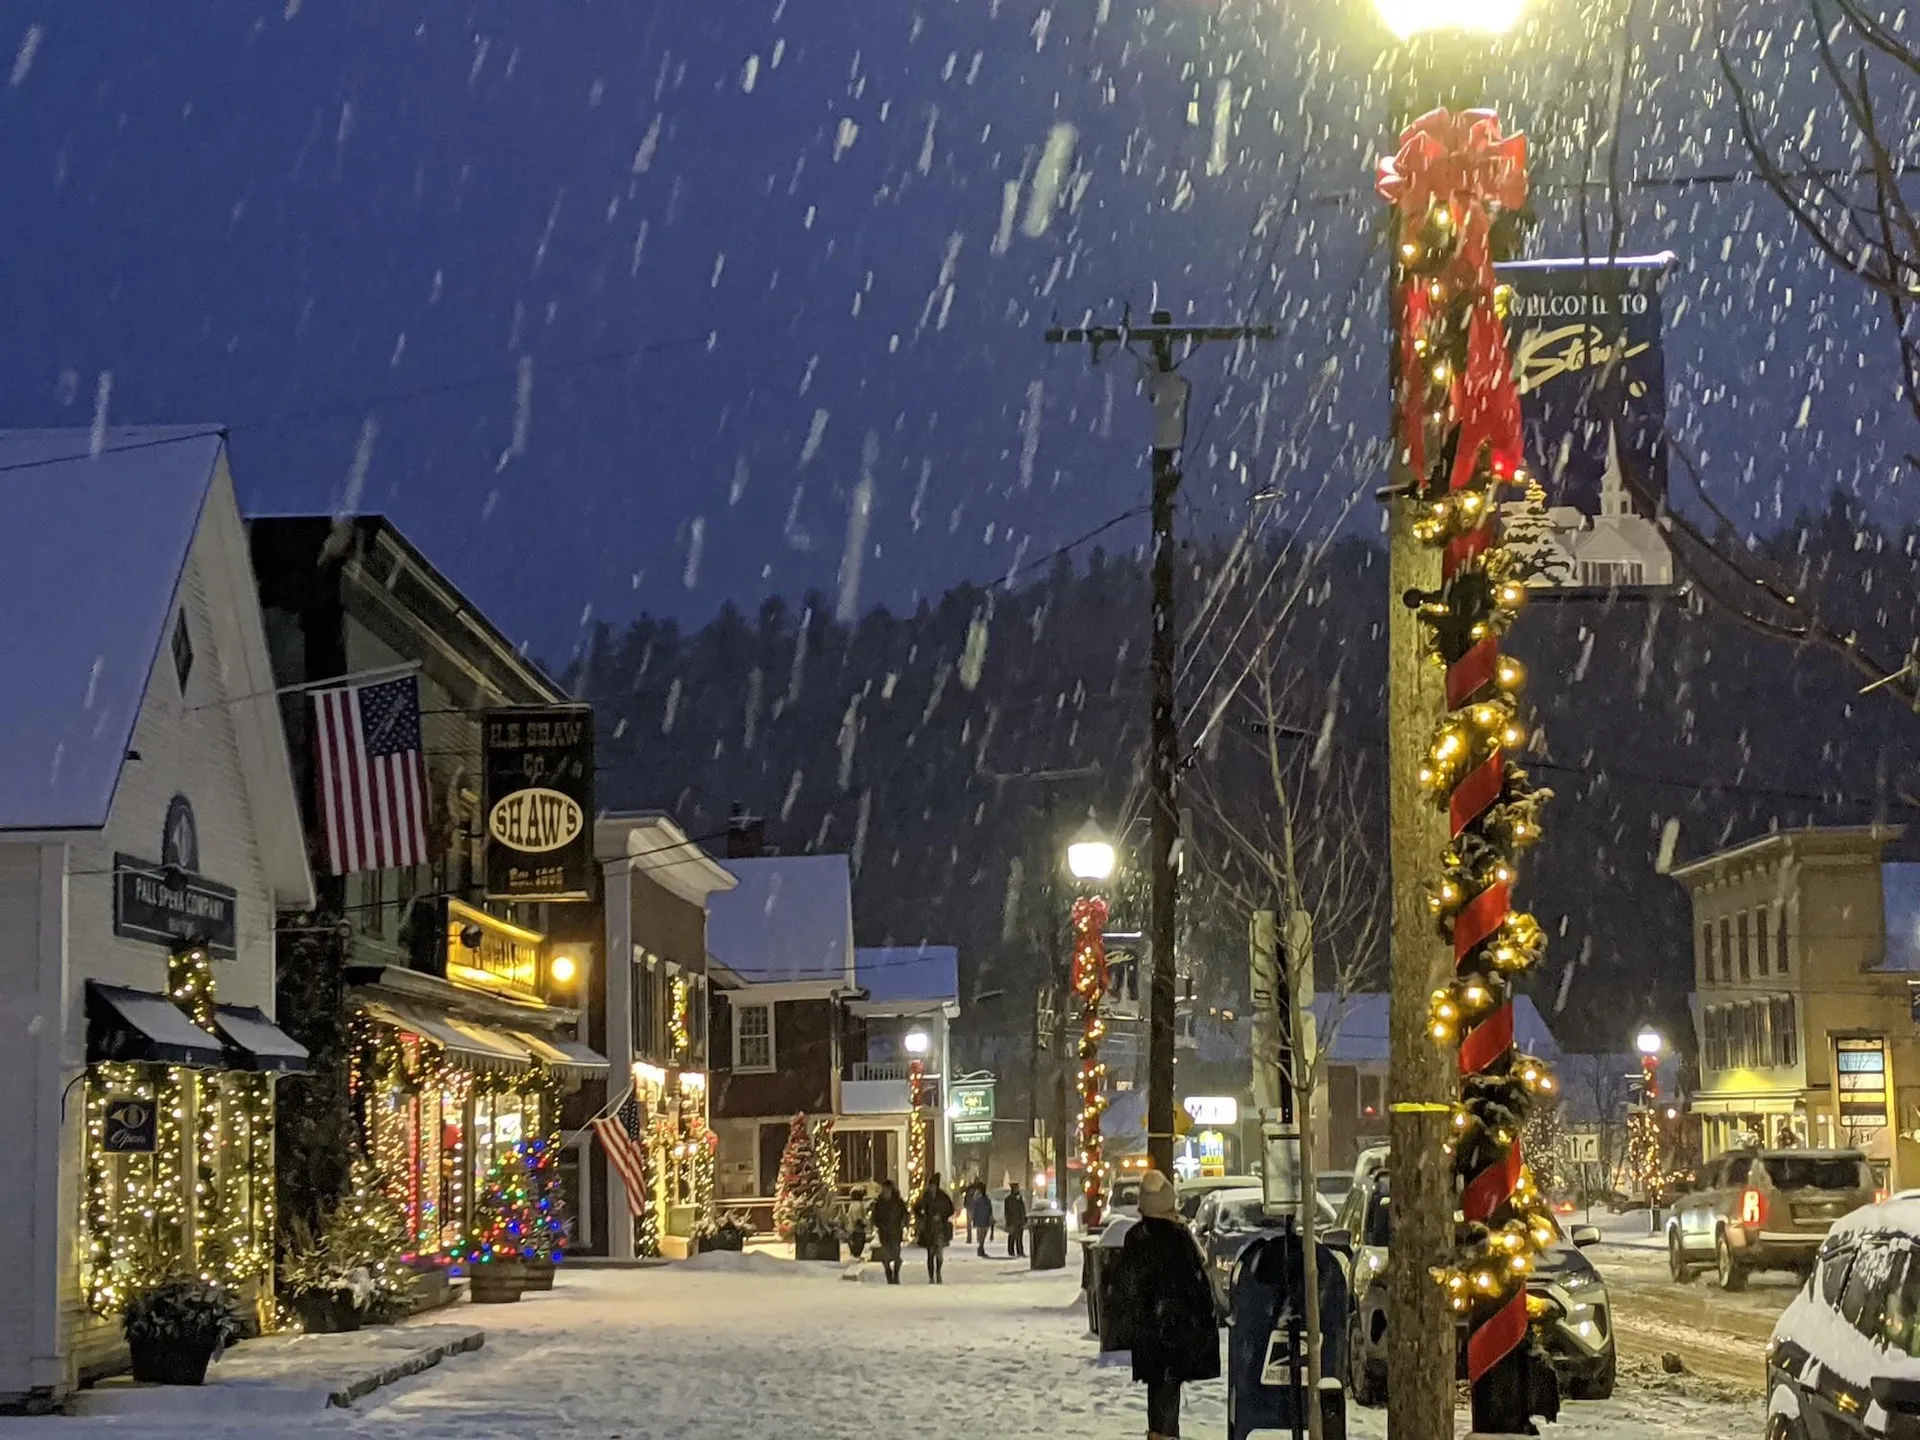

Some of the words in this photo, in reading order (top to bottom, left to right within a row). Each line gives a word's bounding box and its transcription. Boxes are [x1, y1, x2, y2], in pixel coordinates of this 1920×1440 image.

[1618, 292, 1648, 315] TO
[1518, 323, 1649, 394] Stow
[496, 793, 577, 847] SHAW'S
